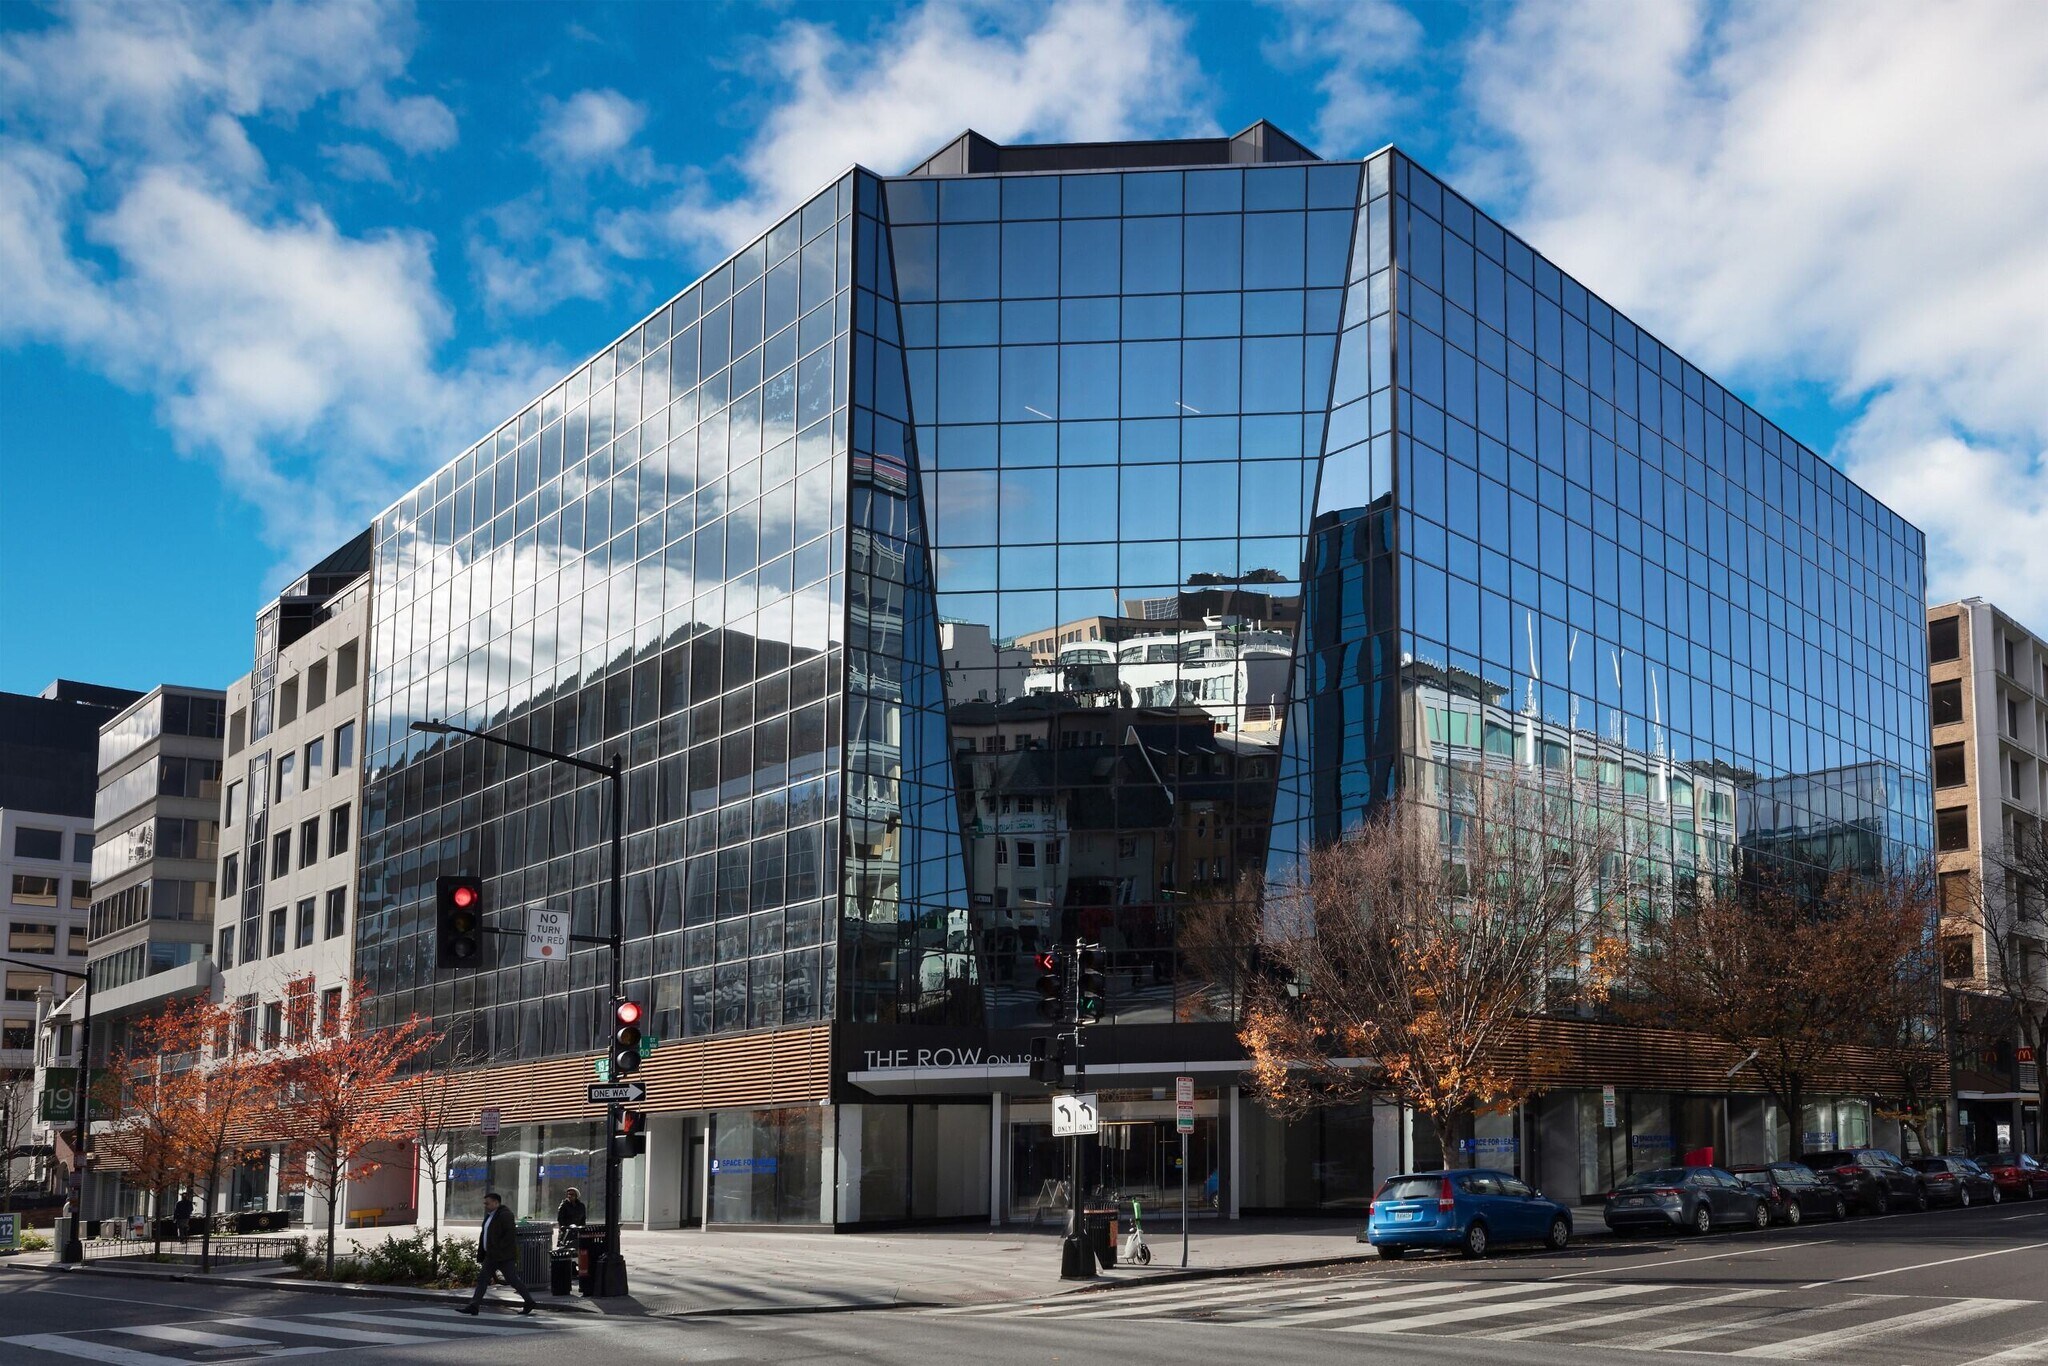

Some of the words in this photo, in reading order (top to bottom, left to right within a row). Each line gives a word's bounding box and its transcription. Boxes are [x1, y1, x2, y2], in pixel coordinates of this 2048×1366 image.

[540, 913, 558, 924] NO
[537, 925, 561, 935] TURN
[530, 935, 543, 943] ON
[547, 936, 565, 945] RED
[864, 1050, 908, 1071] THE
[917, 1048, 982, 1069] ROW
[986, 1055, 1011, 1067] ON
[594, 1089, 610, 1098] ONE
[612, 1088, 629, 1097] WAY
[45, 1088, 74, 1110] 19
[722, 1159, 742, 1167] SPACE
[1, 1224, 13, 1236] 12
